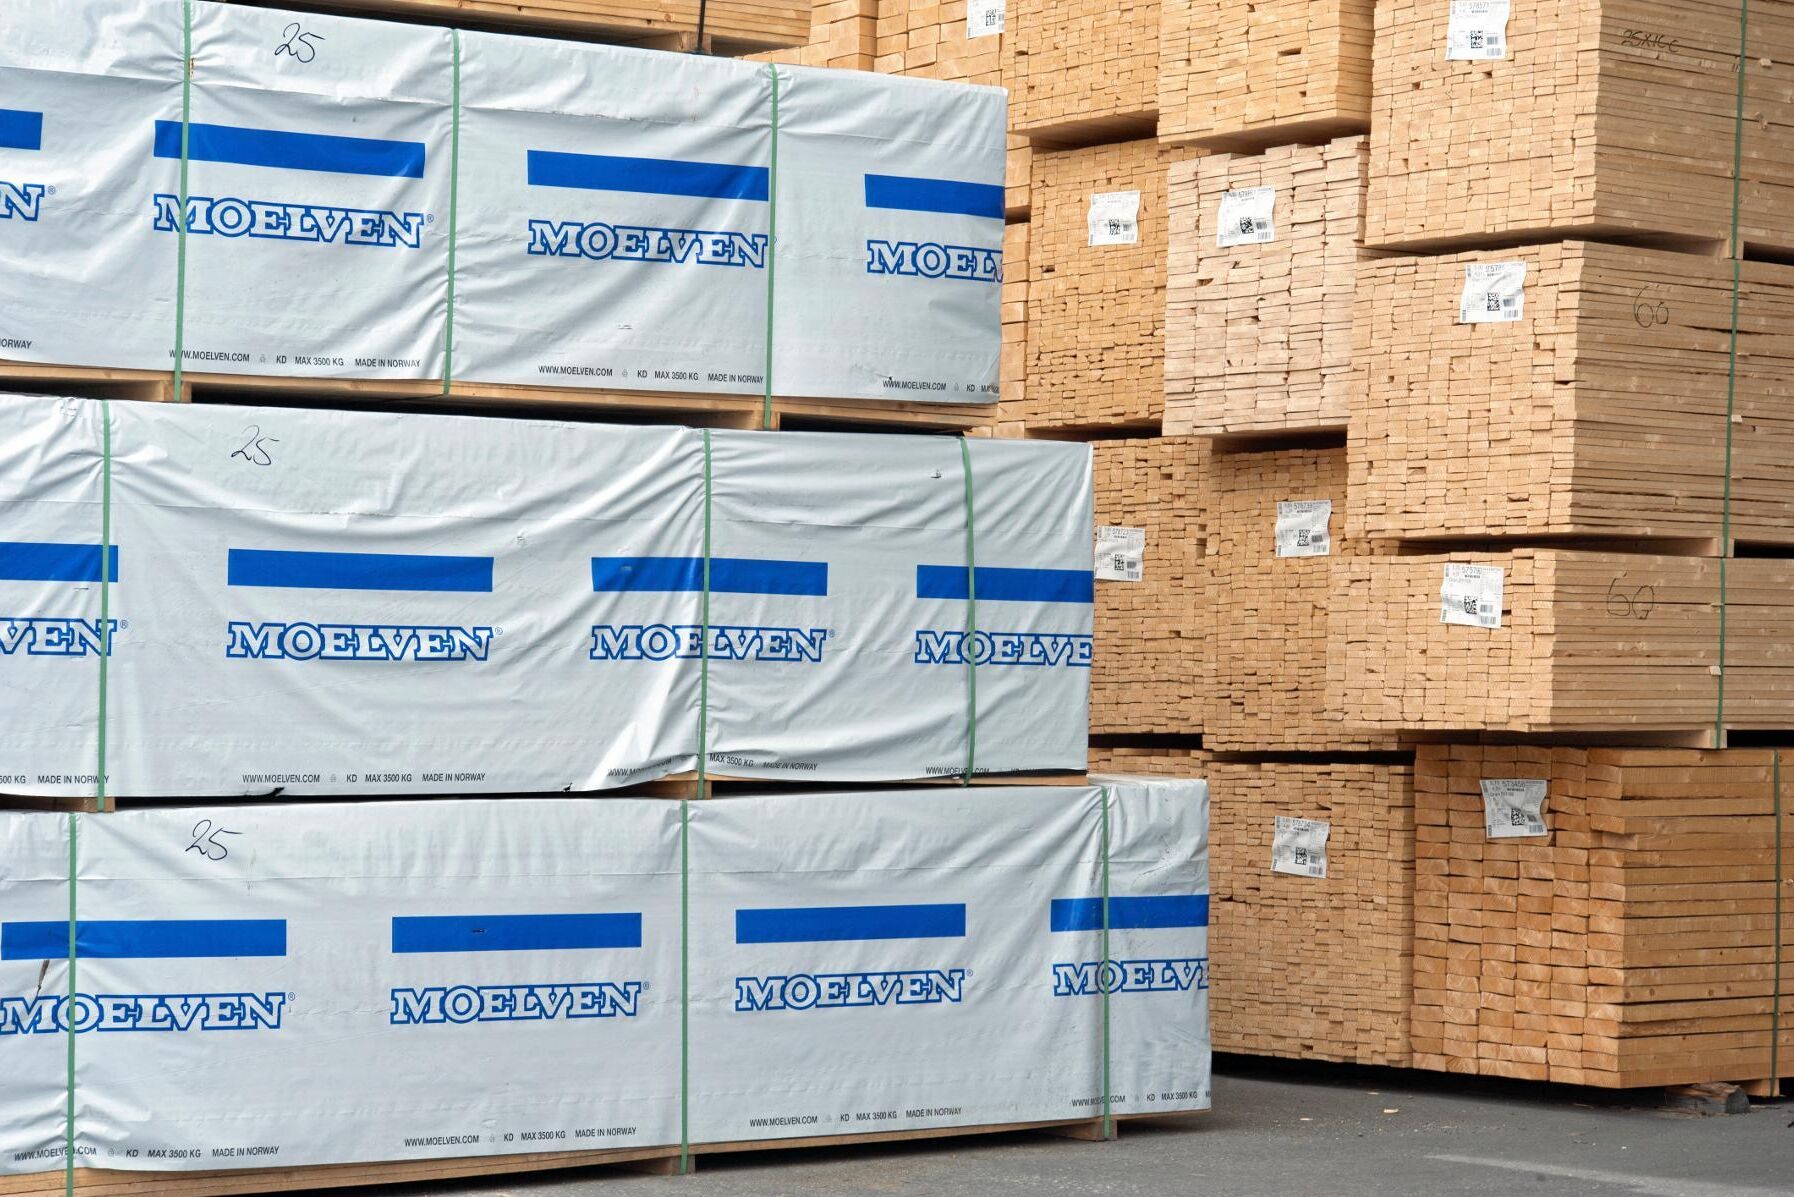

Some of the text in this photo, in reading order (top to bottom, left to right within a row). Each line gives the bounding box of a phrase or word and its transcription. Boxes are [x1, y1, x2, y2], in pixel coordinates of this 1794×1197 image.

[274, 22, 325, 63] 25
[153, 193, 424, 249] MOELVEN
[528, 219, 767, 269] MOELVEN
[0, 338, 32, 349] ORWAY
[276, 355, 287, 364] KD
[295, 356, 311, 365] MAX
[313, 357, 331, 366] 3500
[332, 358, 344, 366] KG
[355, 358, 376, 367] MADE
[378, 359, 386, 367] IN
[387, 360, 420, 368] NORWAY
[538, 365, 613, 377] WWW.MOELVEN.COM
[637, 370, 647, 378] KD
[654, 371, 670, 379] MAX
[671, 371, 687, 380] 3500
[708, 373, 727, 382] MADE
[728, 374, 736, 382] IN
[737, 374, 764, 384] NORWAY
[883, 380, 946, 391] WWW.MOELVEN.COM
[966, 384, 976, 392] KD
[231, 424, 281, 466] 25
[225, 620, 494, 662] MOELVEN
[589, 623, 827, 663] MOELVEN
[709, 752, 725, 763] MAX
[726, 757, 742, 766] 3500
[743, 759, 754, 768] KG
[763, 761, 781, 769] MADE
[789, 762, 818, 771] NORWAY
[14, 775, 26, 784] KG
[37, 775, 61, 784] MADE
[63, 775, 72, 784] IN
[74, 775, 110, 784] NORWY
[242, 772, 485, 783] WWW.MOELVEN.COM KD MAX 3500 KG MADE IN NORWAY
[185, 819, 244, 862] 25
[735, 967, 965, 1012] MOELVEN
[389, 980, 642, 1025] MOELVEN
[0, 992, 285, 1036] MOELVEN
[1146, 1093, 1156, 1101] KD
[1161, 1092, 1175, 1100] MAX
[1175, 1091, 1188, 1100] 3500
[1189, 1090, 1198, 1099] KG
[749, 1107, 962, 1127] WWW.MOELVEN.COM KD MAX 3500 KG MADE IN NORWAY
[404, 1127, 637, 1147] WWW.MOELVEN.COM KD MAX 3500 KG MADE IN NORWAY
[14, 1146, 280, 1161] WWW.MOELVE.COM KD MAX 3500 KG MADE IN NORWAY
